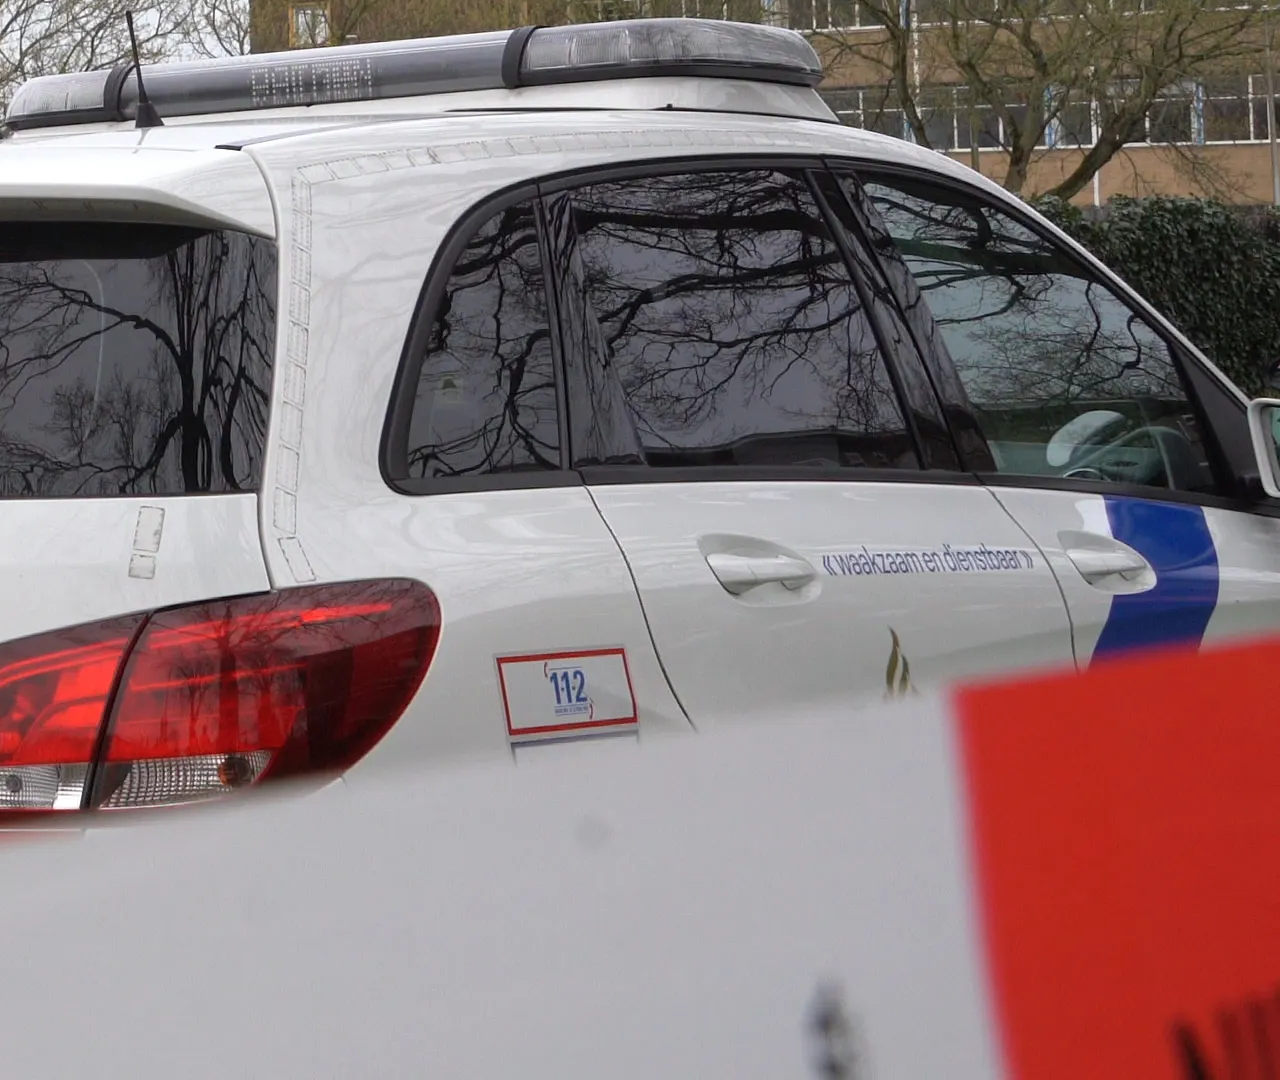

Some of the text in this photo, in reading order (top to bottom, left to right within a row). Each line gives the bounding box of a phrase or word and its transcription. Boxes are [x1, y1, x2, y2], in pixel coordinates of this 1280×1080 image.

[834, 545, 925, 576] waakzaam
[924, 551, 945, 573] en
[942, 543, 1023, 572] dienstbaar
